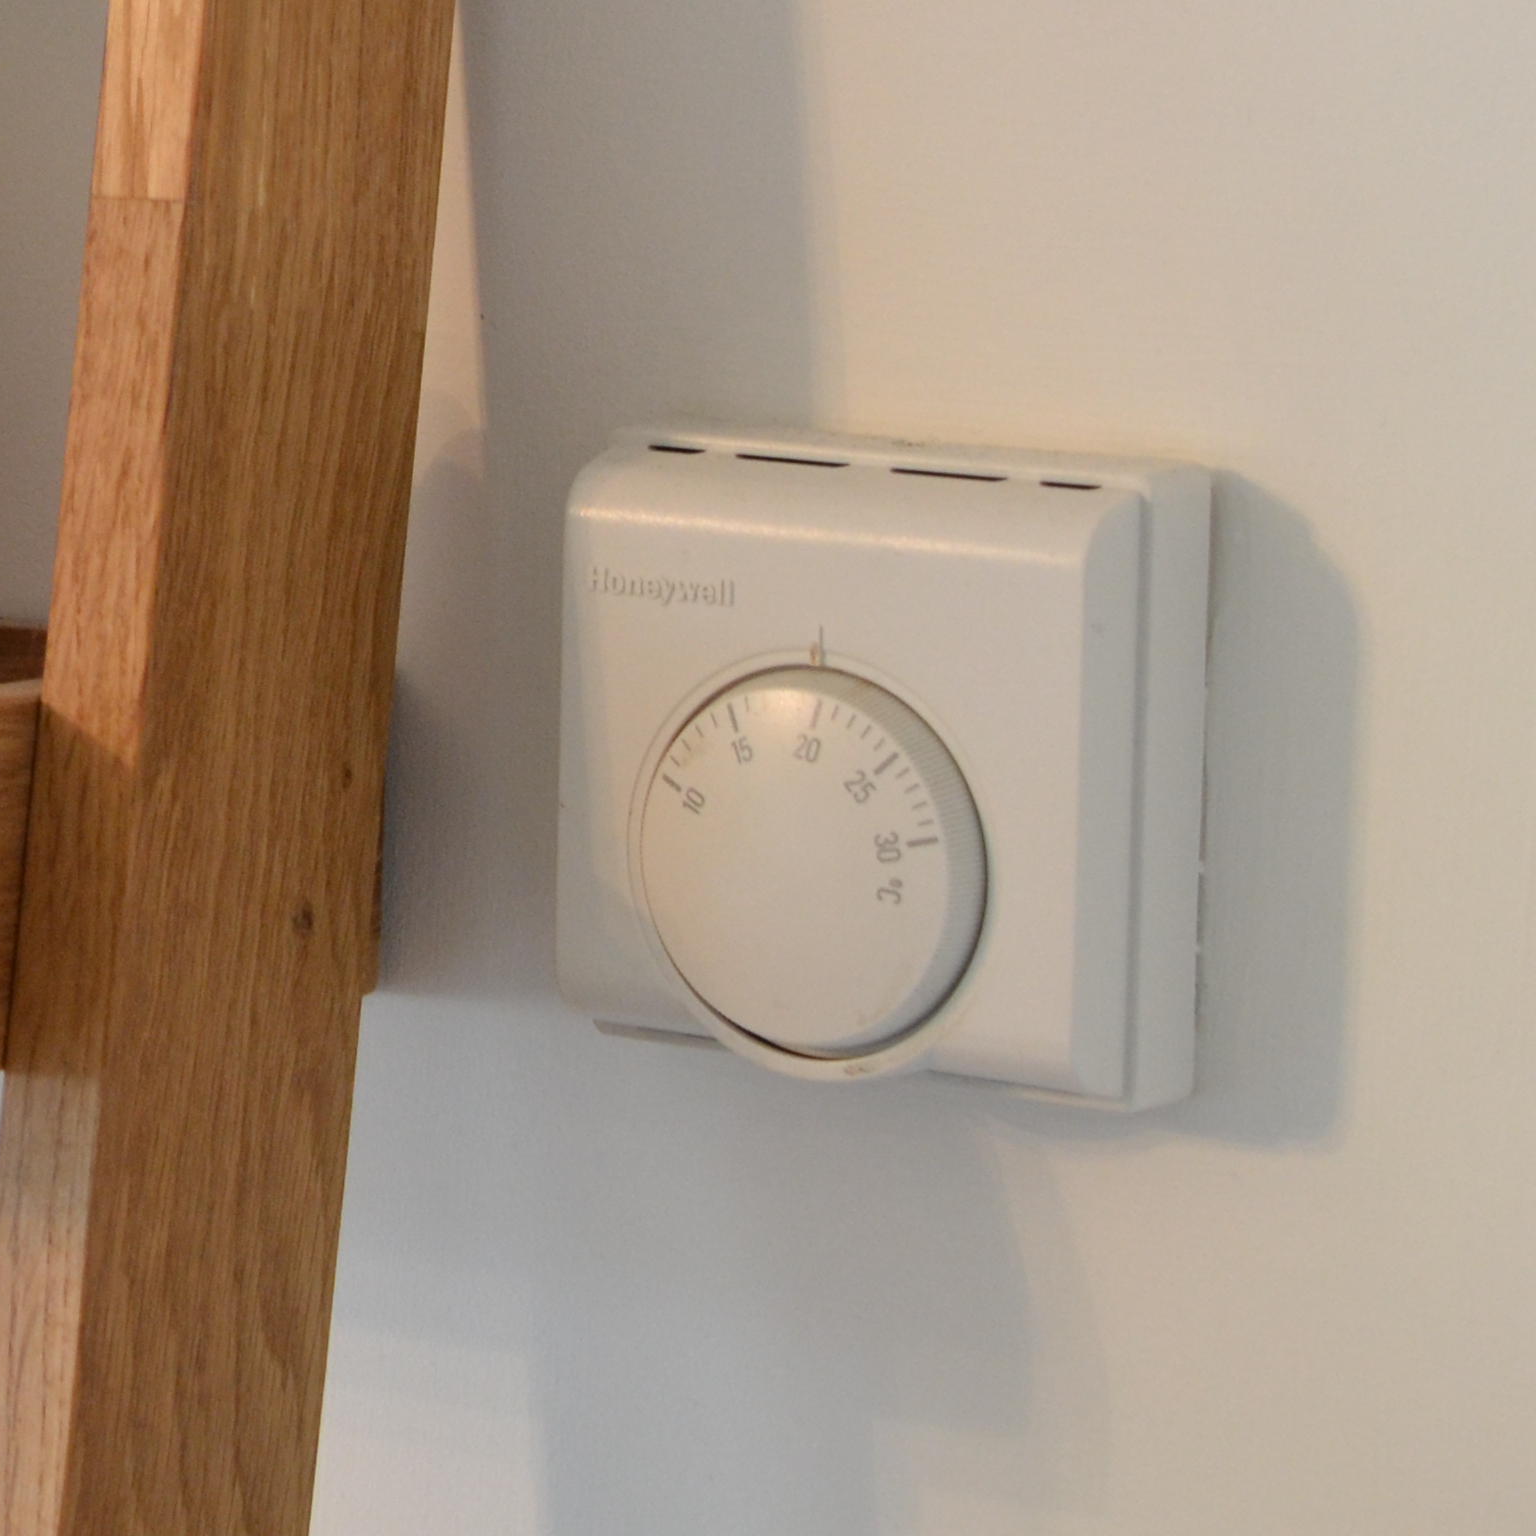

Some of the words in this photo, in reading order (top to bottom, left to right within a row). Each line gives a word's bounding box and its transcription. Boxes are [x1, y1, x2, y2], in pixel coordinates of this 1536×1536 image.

[588, 566, 736, 608] Honeywell
[731, 736, 754, 764] 15
[793, 733, 821, 763] 20
[682, 786, 706, 815] 10
[843, 769, 877, 804] 25
[874, 831, 902, 864] 30
